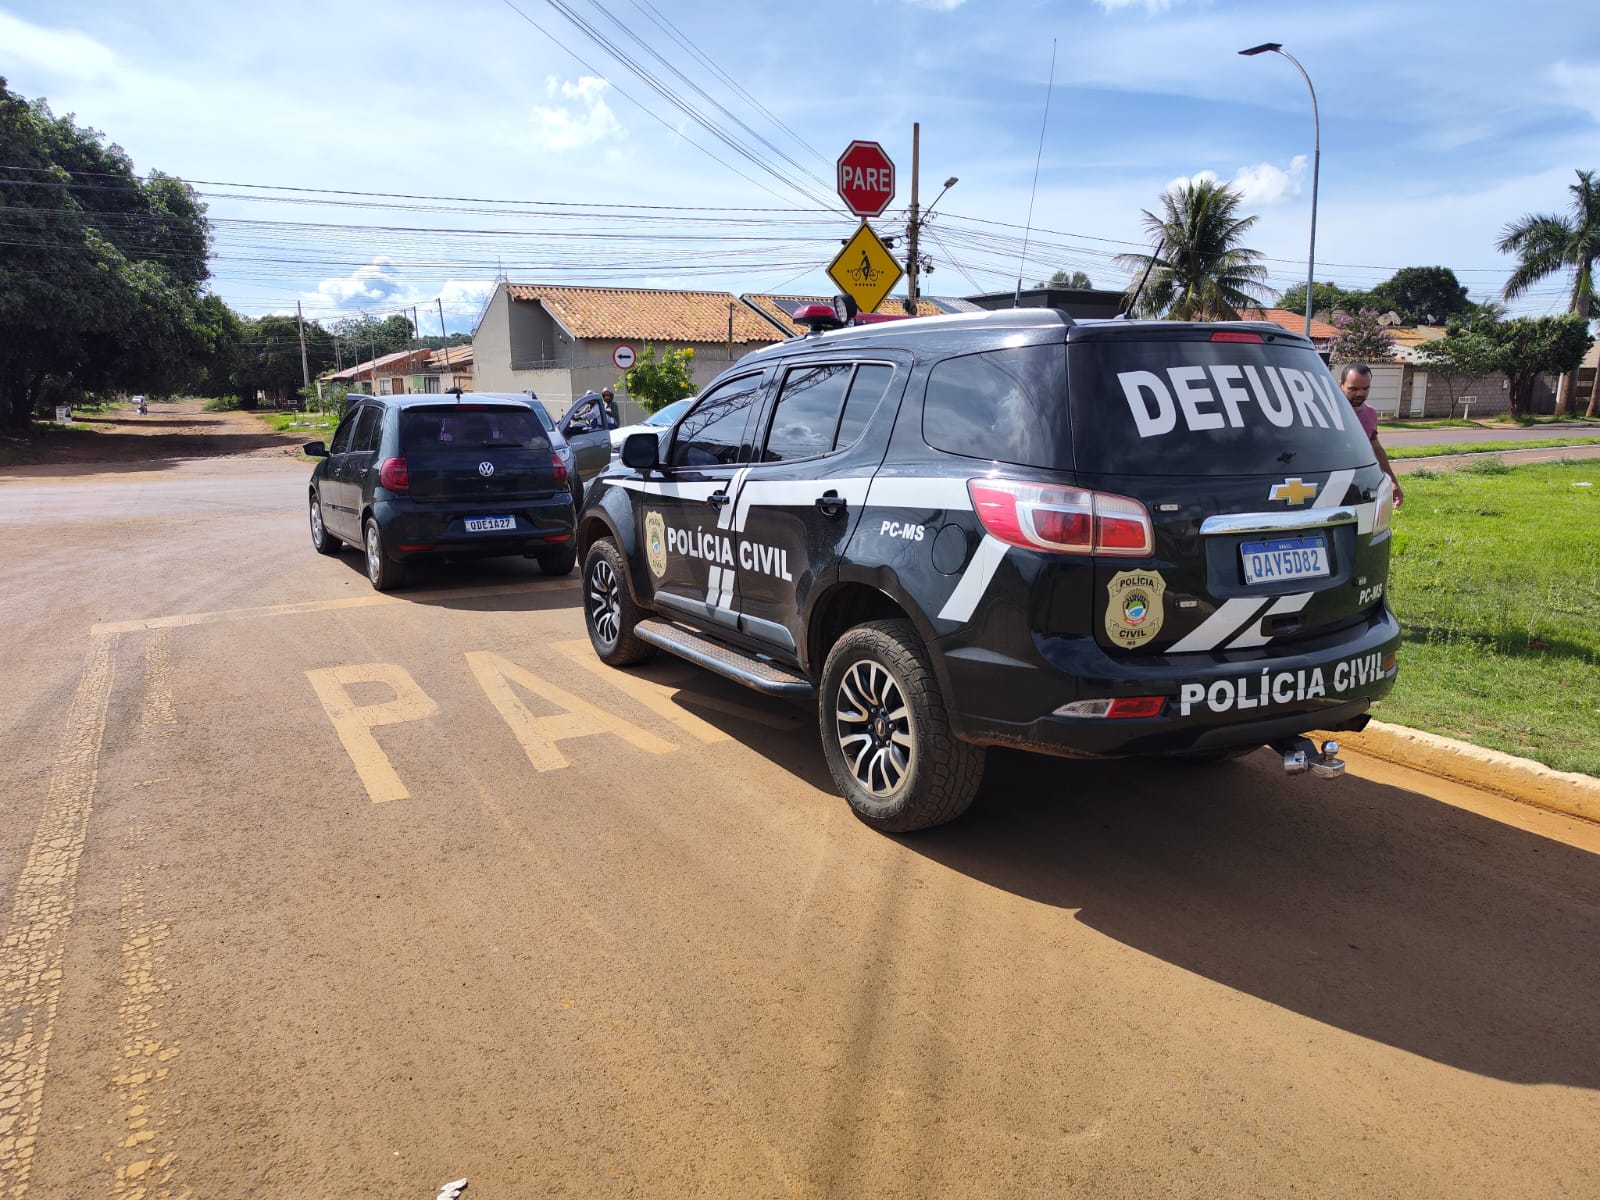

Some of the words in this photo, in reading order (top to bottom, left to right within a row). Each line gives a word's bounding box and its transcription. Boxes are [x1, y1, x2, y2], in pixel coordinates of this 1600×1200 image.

[842, 165, 890, 192] PARE
[1116, 364, 1345, 438] DEFURV
[880, 520, 925, 541] PC-MS
[667, 525, 735, 566] POLÍCIA
[739, 540, 793, 582] CIVIL
[1252, 550, 1321, 578] QAY5D82
[1120, 575, 1154, 588] POLÍCIA
[1359, 583, 1383, 606] PC-MS
[1119, 629, 1147, 638] CIVIL
[1180, 667, 1326, 717] POLÍCIA
[1333, 652, 1385, 693] CIVIL
